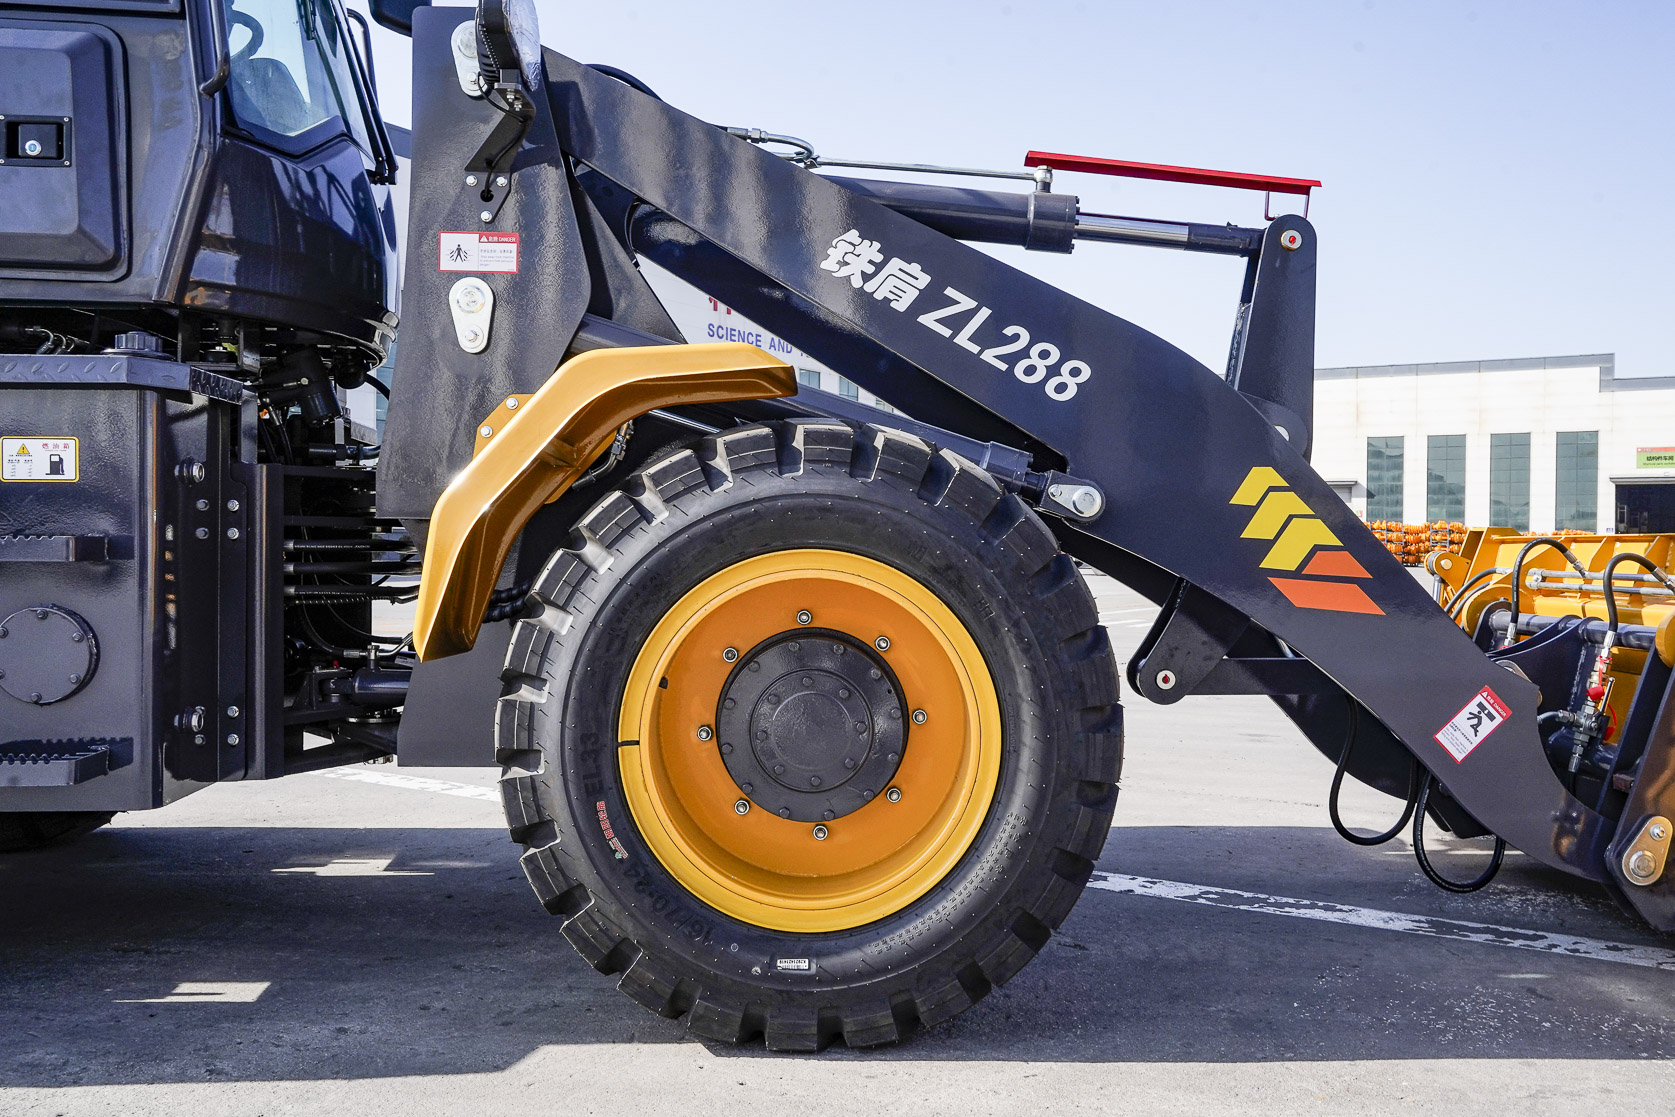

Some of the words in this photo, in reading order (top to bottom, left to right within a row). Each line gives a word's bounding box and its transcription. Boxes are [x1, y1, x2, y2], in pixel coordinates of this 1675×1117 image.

[707, 323, 762, 348] SCIENCE
[769, 337, 793, 354] AND
[820, 229, 932, 312] 铁肩
[916, 286, 1091, 401] ZL288
[1493, 703, 1507, 717] DANGER
[580, 731, 605, 798] EL33
